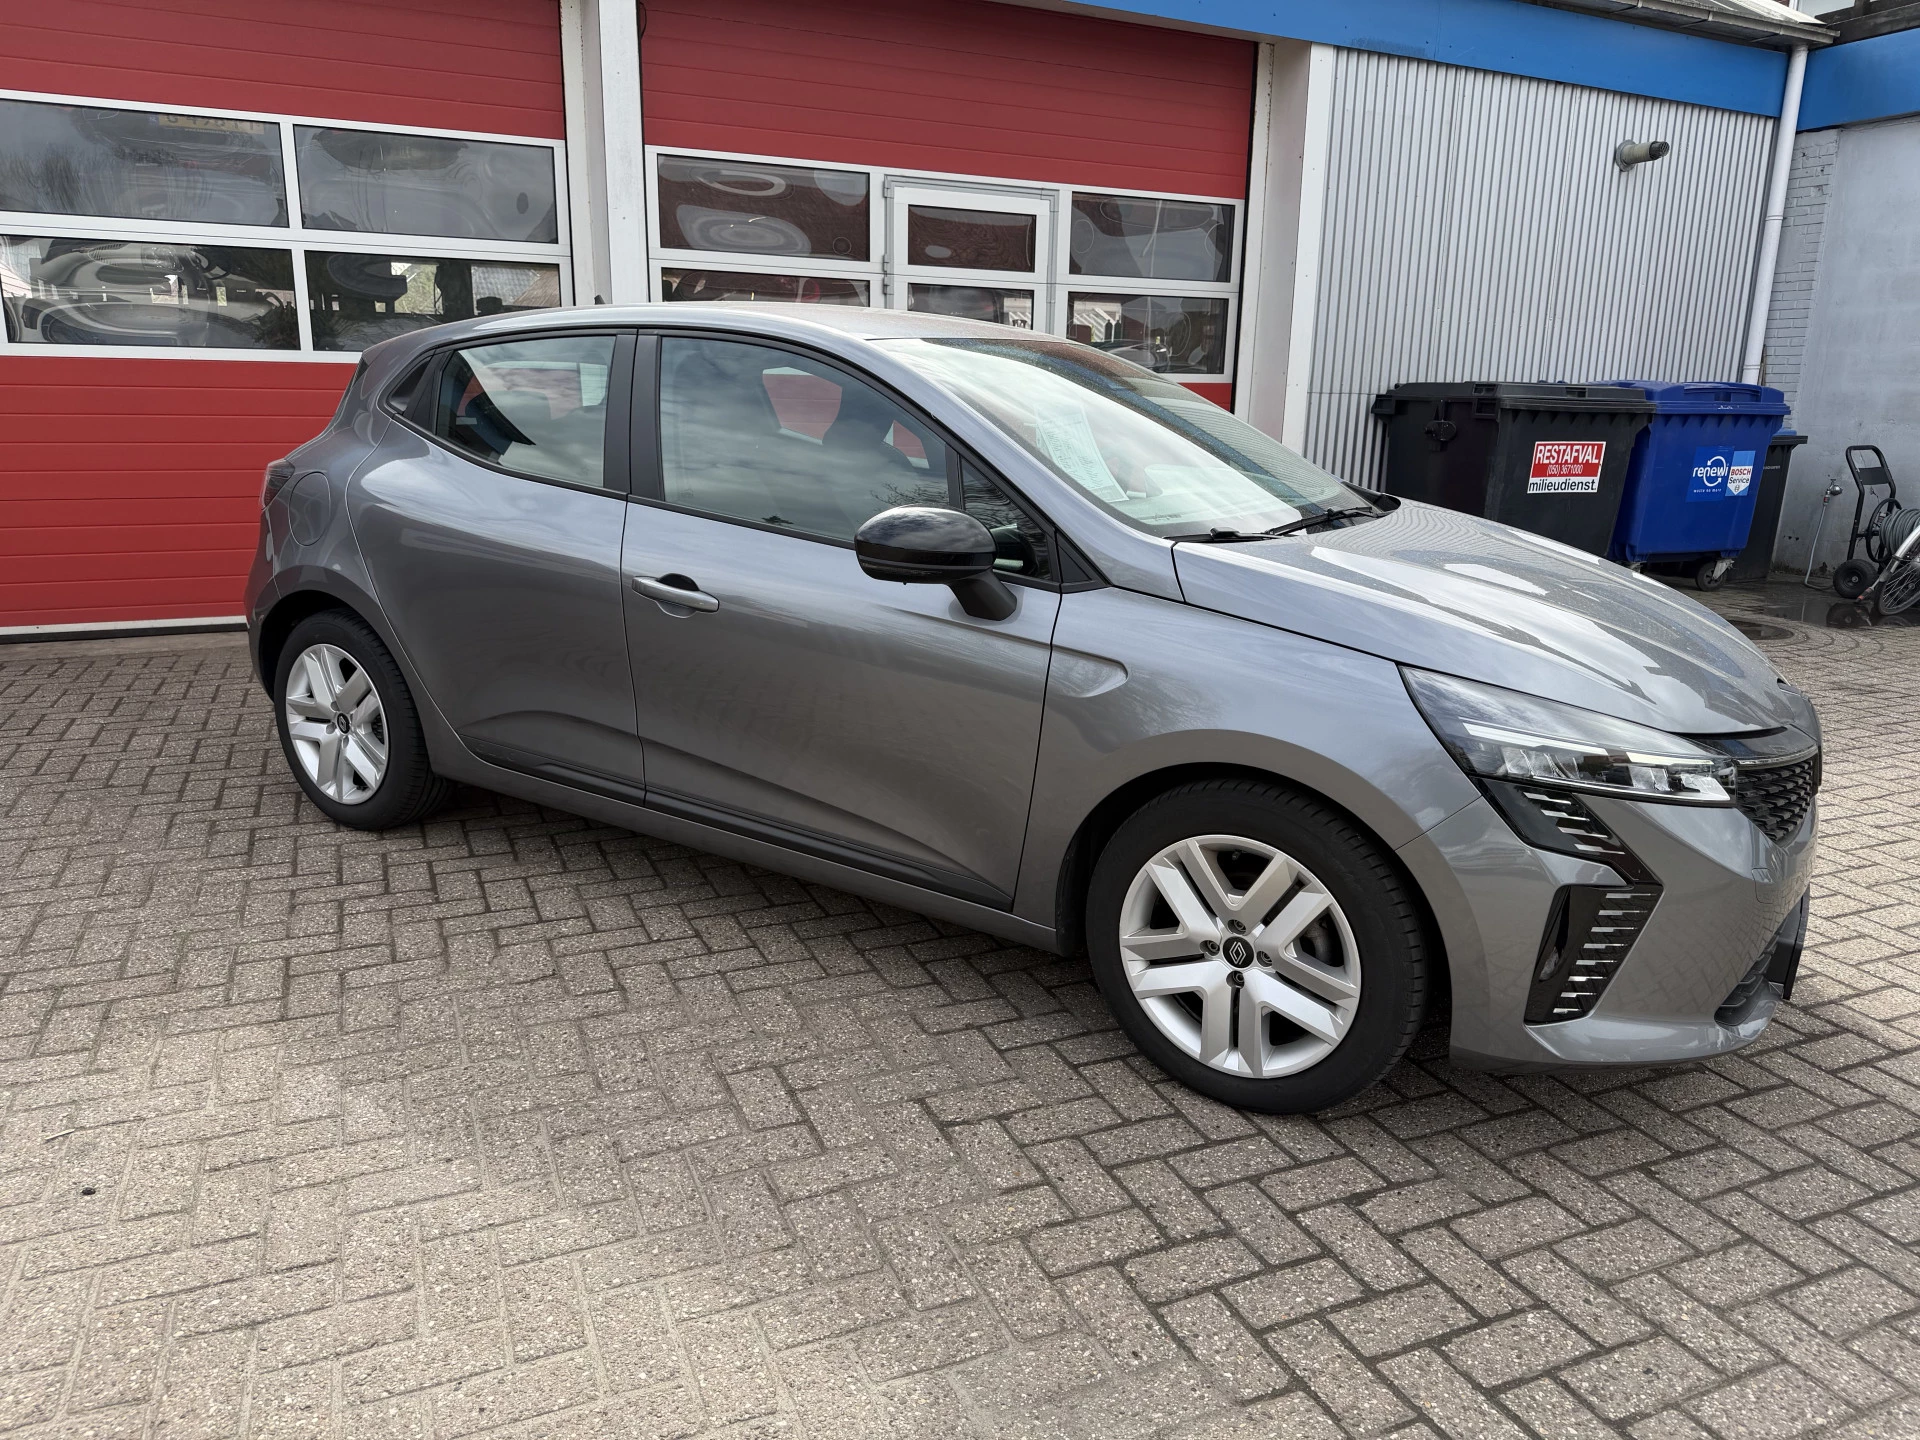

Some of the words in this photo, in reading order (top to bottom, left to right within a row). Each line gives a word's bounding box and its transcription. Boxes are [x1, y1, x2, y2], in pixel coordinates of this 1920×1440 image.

[1535, 445, 1599, 464] RESTAFVAL
[1546, 464, 1560, 476] (050)
[1560, 464, 1584, 475] 3671000
[1692, 463, 1729, 478] renewi
[1730, 468, 1752, 476] BOSCH
[1728, 476, 1750, 484] Service
